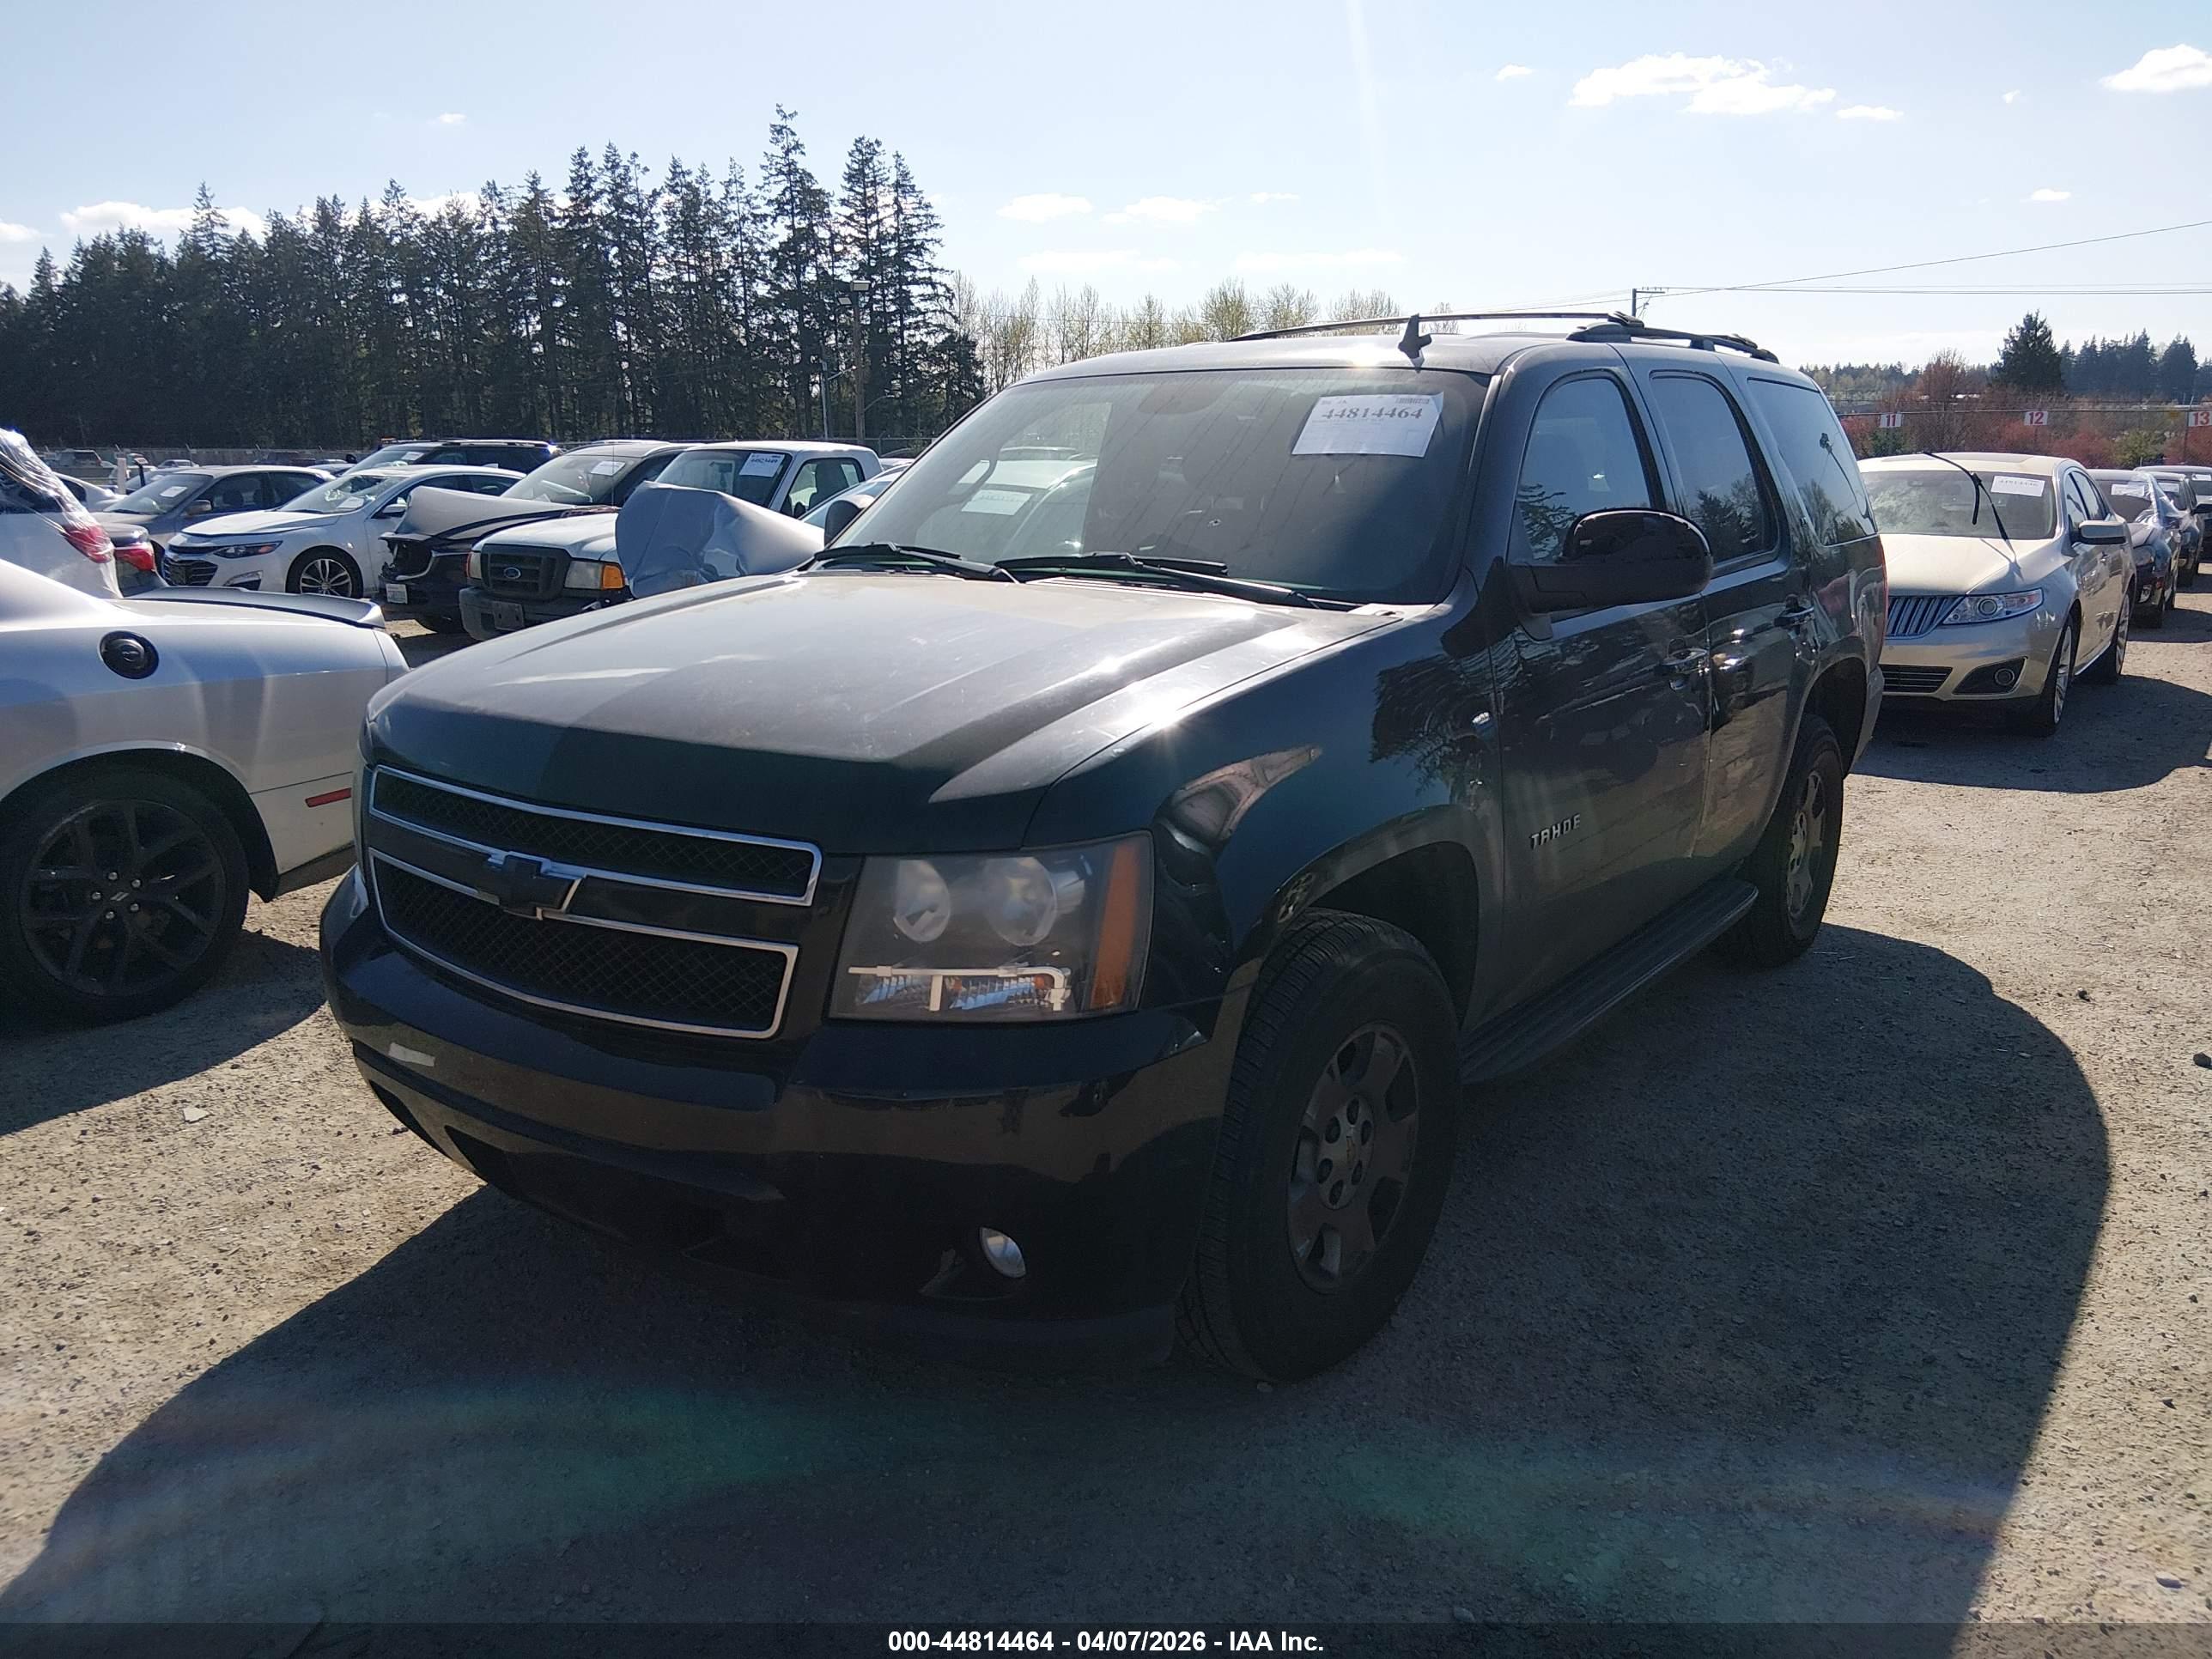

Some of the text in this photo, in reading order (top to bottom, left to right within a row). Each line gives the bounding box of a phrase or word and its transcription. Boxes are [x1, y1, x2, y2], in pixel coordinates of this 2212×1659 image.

[1322, 406, 1423, 419] 44814464
[2029, 411, 2044, 424] 12
[2192, 411, 2209, 426] 13
[1886, 414, 1896, 426] 11
[1531, 812, 1581, 850] TAHOE
